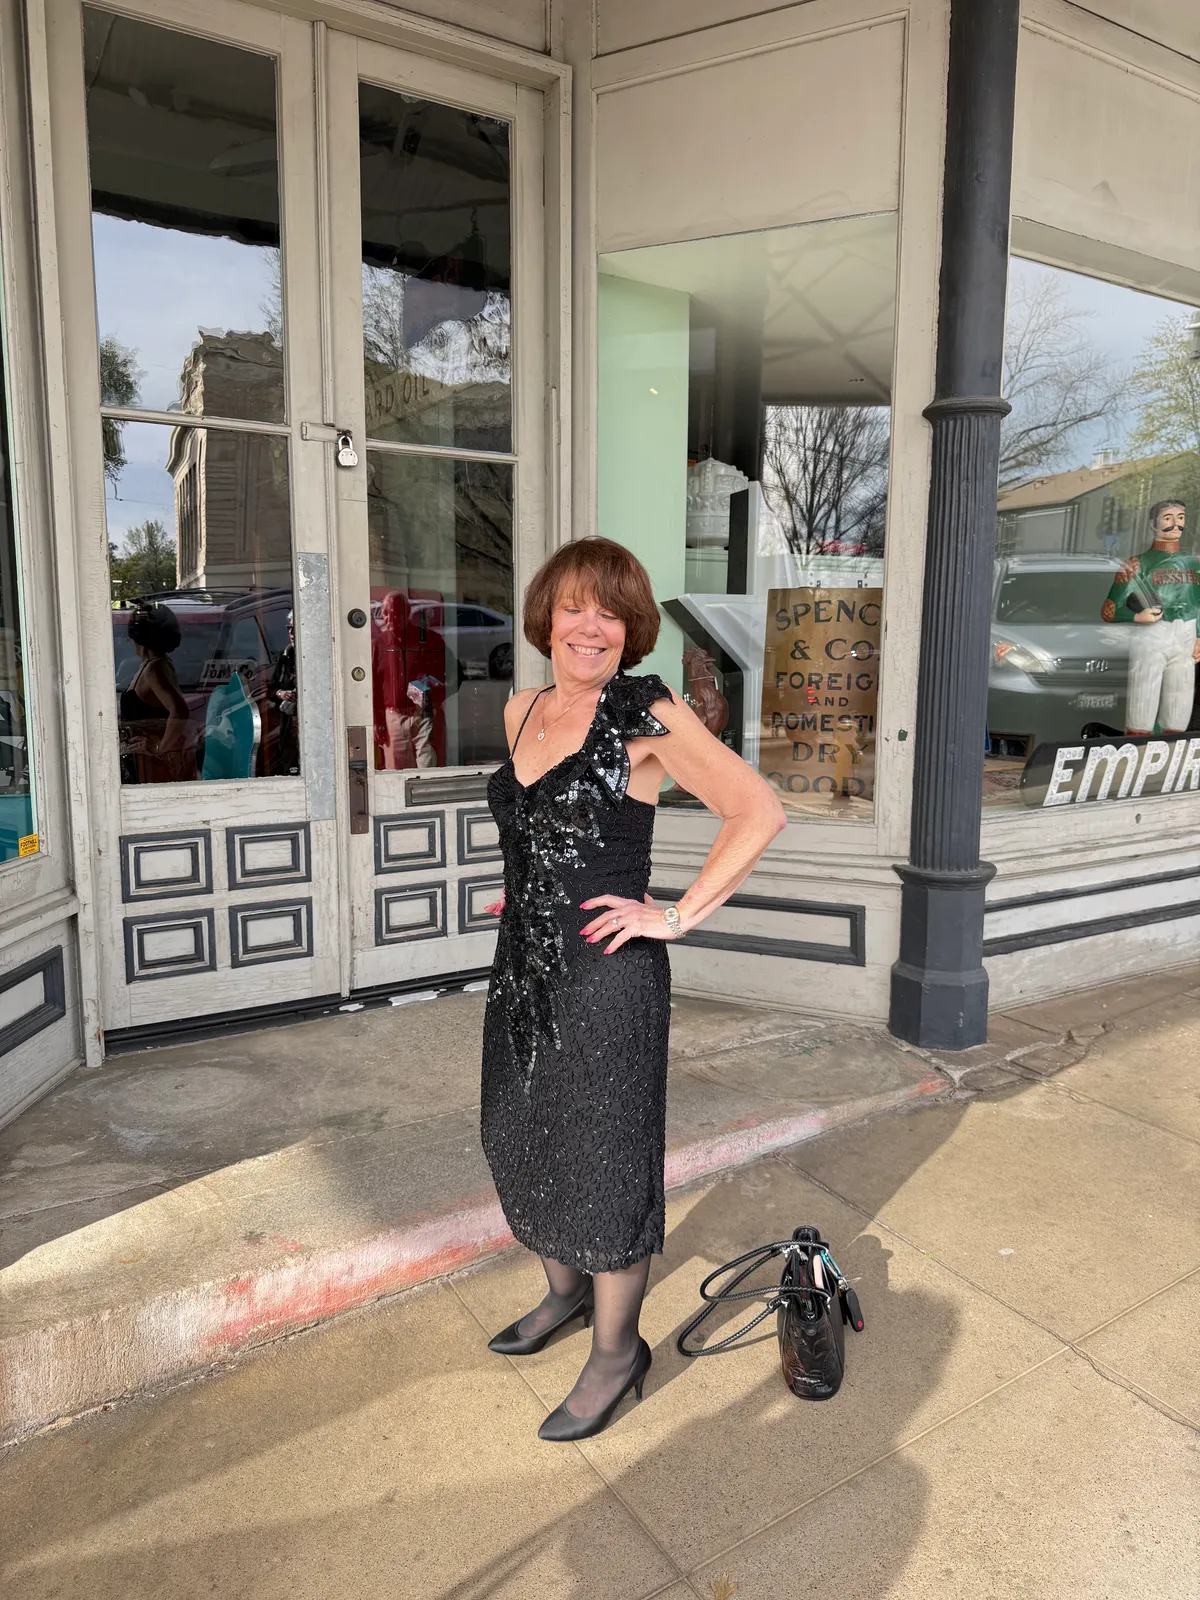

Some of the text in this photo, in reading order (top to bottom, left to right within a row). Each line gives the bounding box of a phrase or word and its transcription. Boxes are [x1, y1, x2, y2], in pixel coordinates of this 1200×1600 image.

[790, 640, 811, 660] &
[776, 671, 880, 691] FOREIG
[810, 697, 849, 707] AND
[792, 741, 868, 765] DRY
